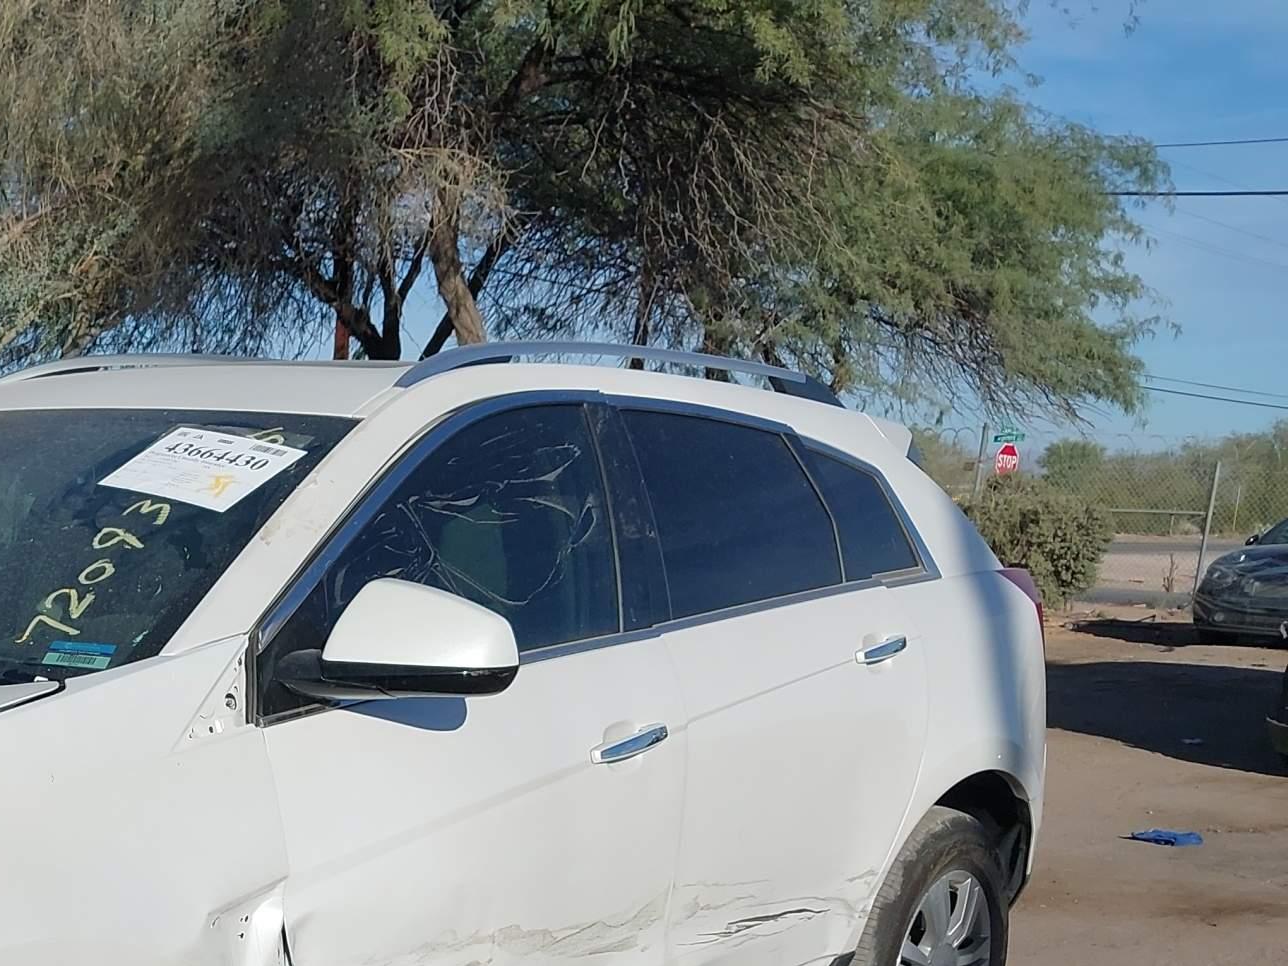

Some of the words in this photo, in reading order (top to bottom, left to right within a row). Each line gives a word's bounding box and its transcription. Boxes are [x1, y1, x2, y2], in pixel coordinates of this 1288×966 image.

[165, 443, 270, 471] 43664430
[997, 454, 1017, 470] STOP
[14, 499, 171, 644] 72093
